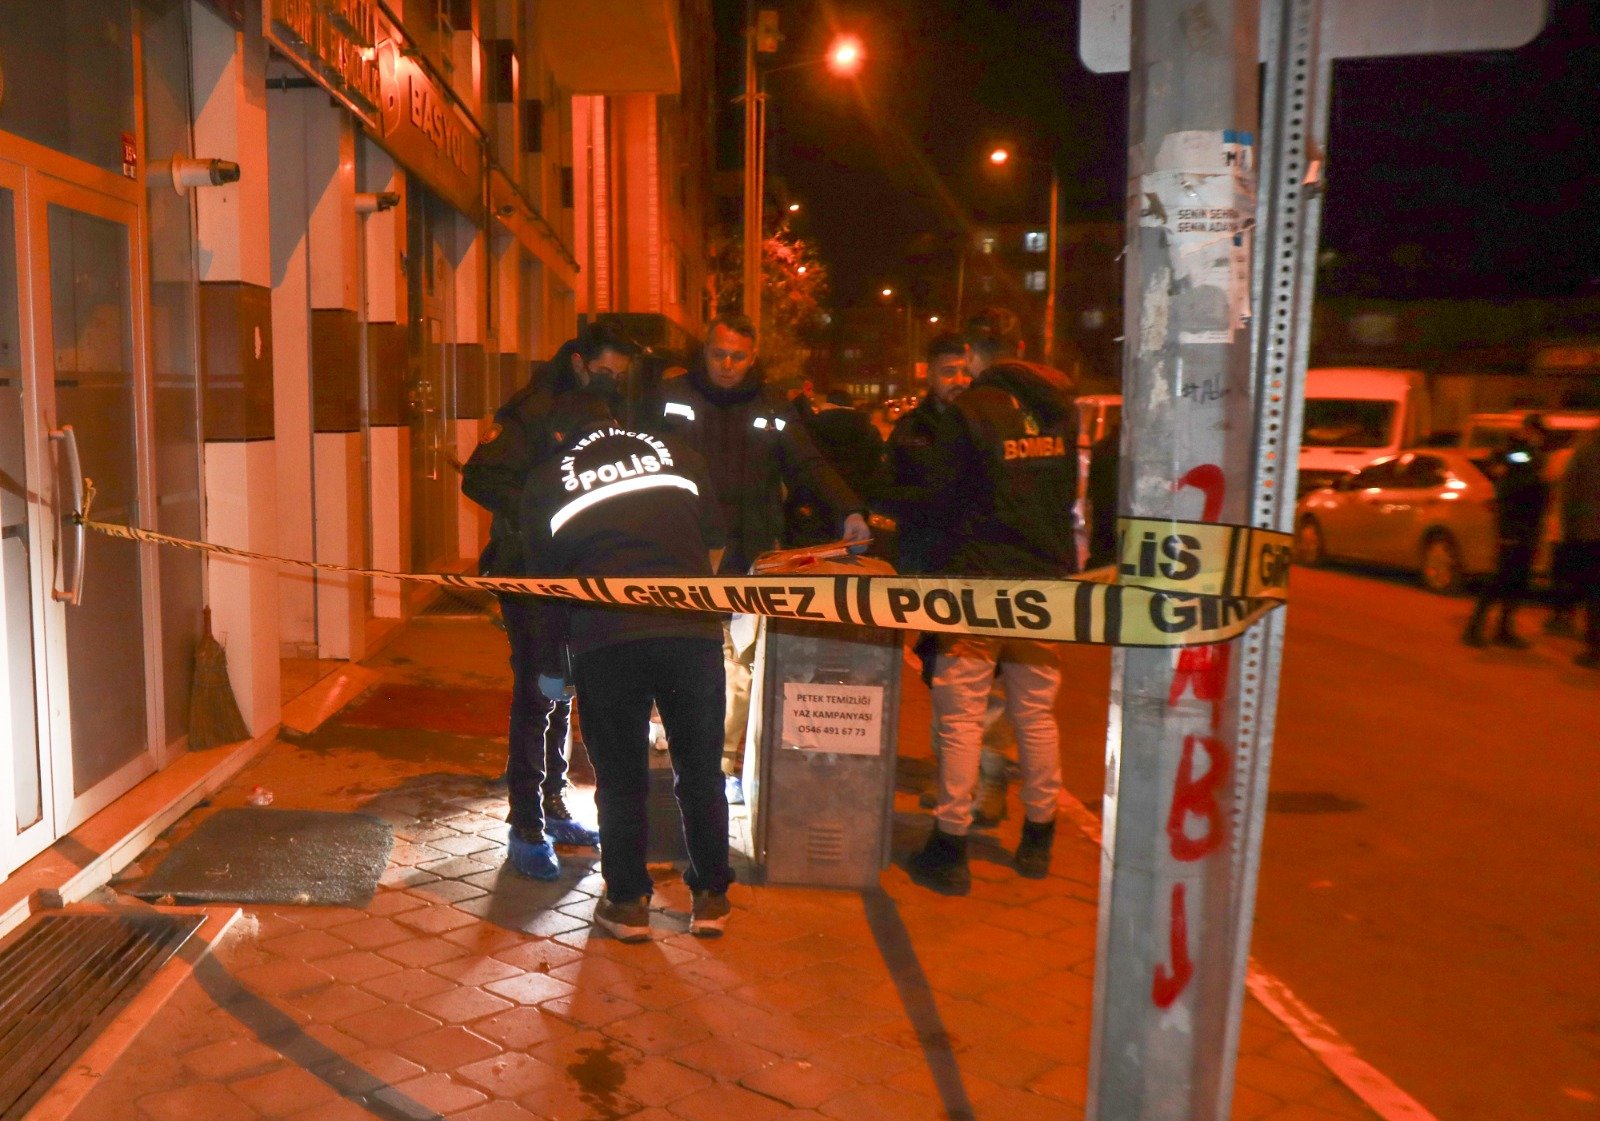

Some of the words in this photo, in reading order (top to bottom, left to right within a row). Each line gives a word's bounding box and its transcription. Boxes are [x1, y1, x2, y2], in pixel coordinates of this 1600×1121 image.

[1003, 436, 1065, 460] BOMBA
[561, 456, 579, 491] OLAY
[578, 453, 661, 490] POLİS
[623, 584, 826, 620] GİRİLMEZ
[886, 588, 1052, 631] POLİS
[797, 694, 823, 703] PETEK
[793, 709, 812, 717] YAZ
[813, 710, 873, 721] KAMPANYASI
[823, 726, 839, 735] 491
[855, 728, 866, 736] 73
